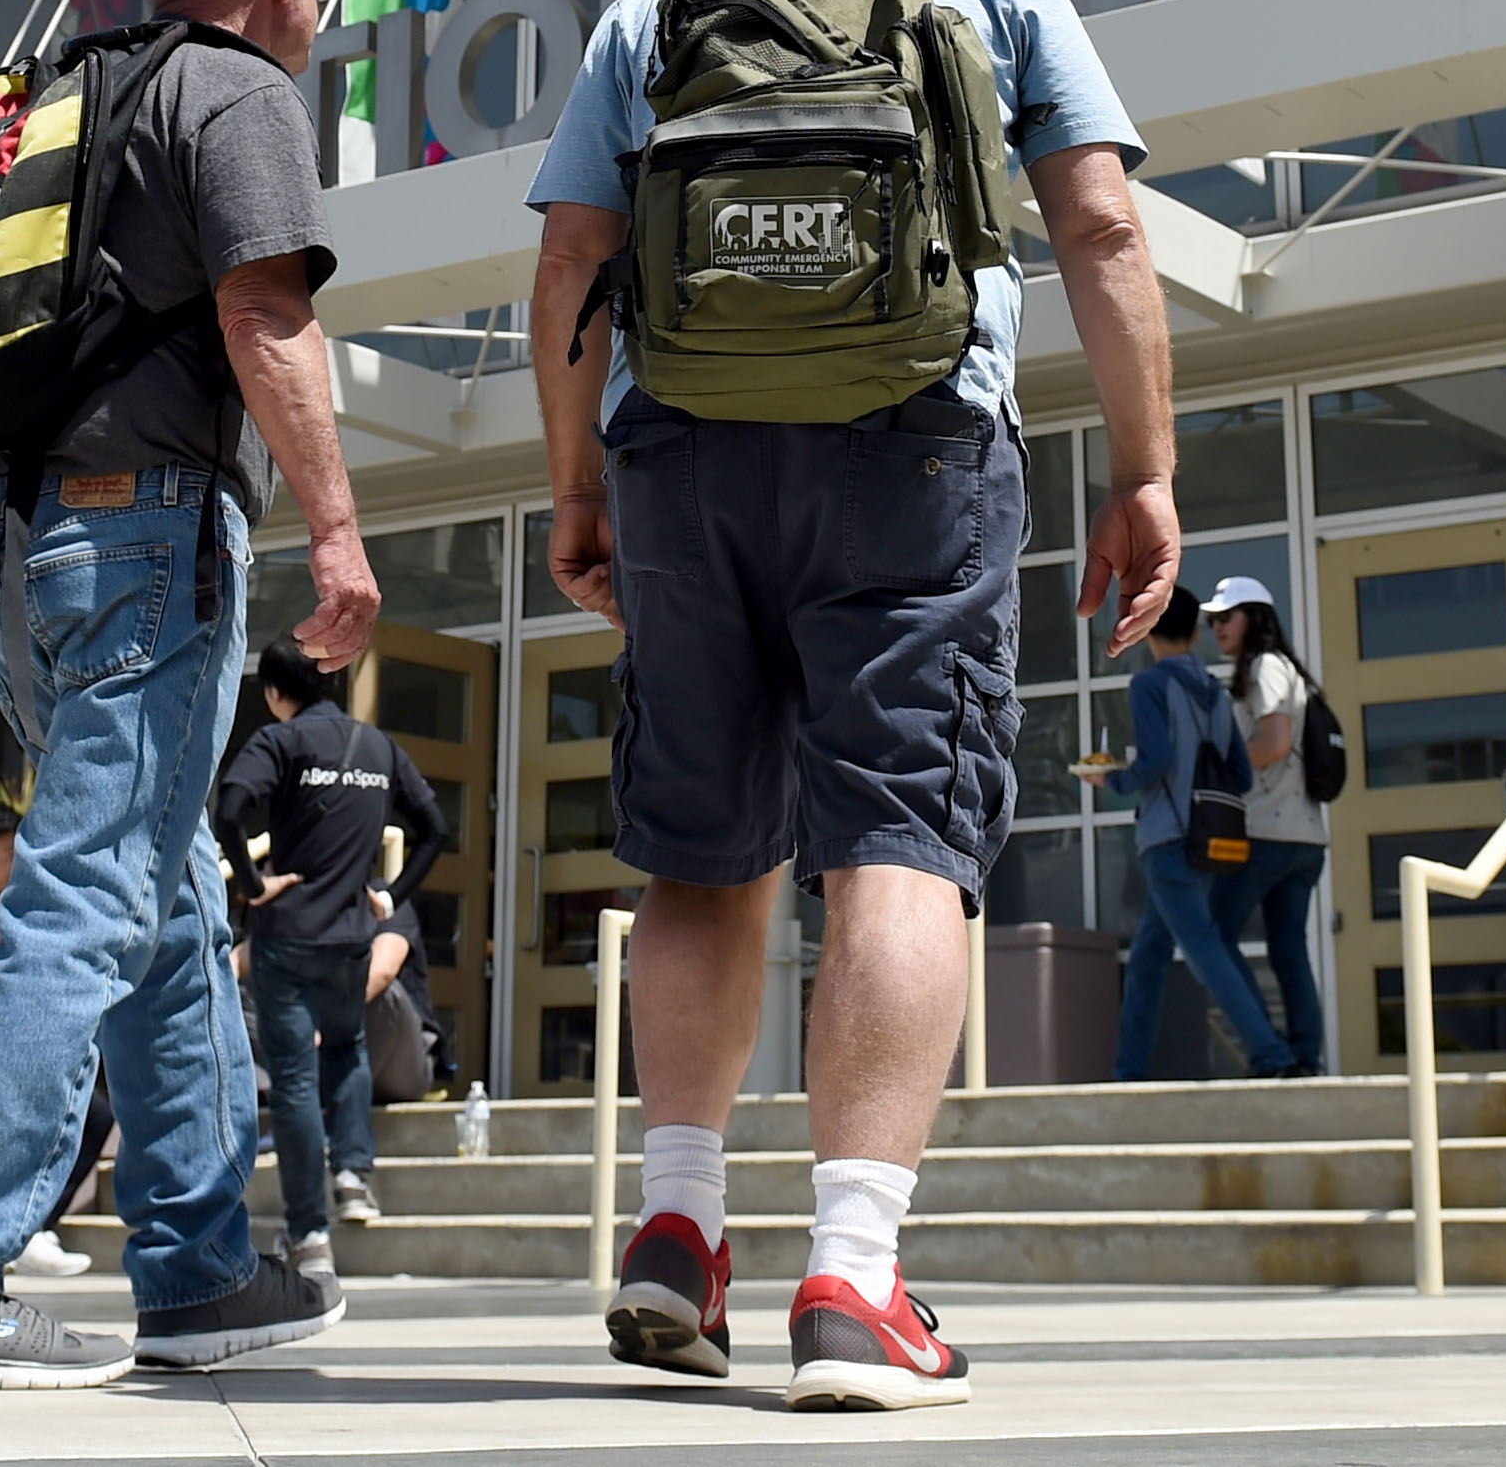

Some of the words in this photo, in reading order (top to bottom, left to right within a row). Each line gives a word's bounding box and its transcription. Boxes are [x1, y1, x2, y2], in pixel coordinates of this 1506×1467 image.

[714, 203, 844, 250] CERT
[715, 252, 781, 265] COMMUNITY
[785, 252, 849, 263] EMERGENCY
[737, 265, 791, 274] RESPONSE
[794, 263, 823, 274] TEAM
